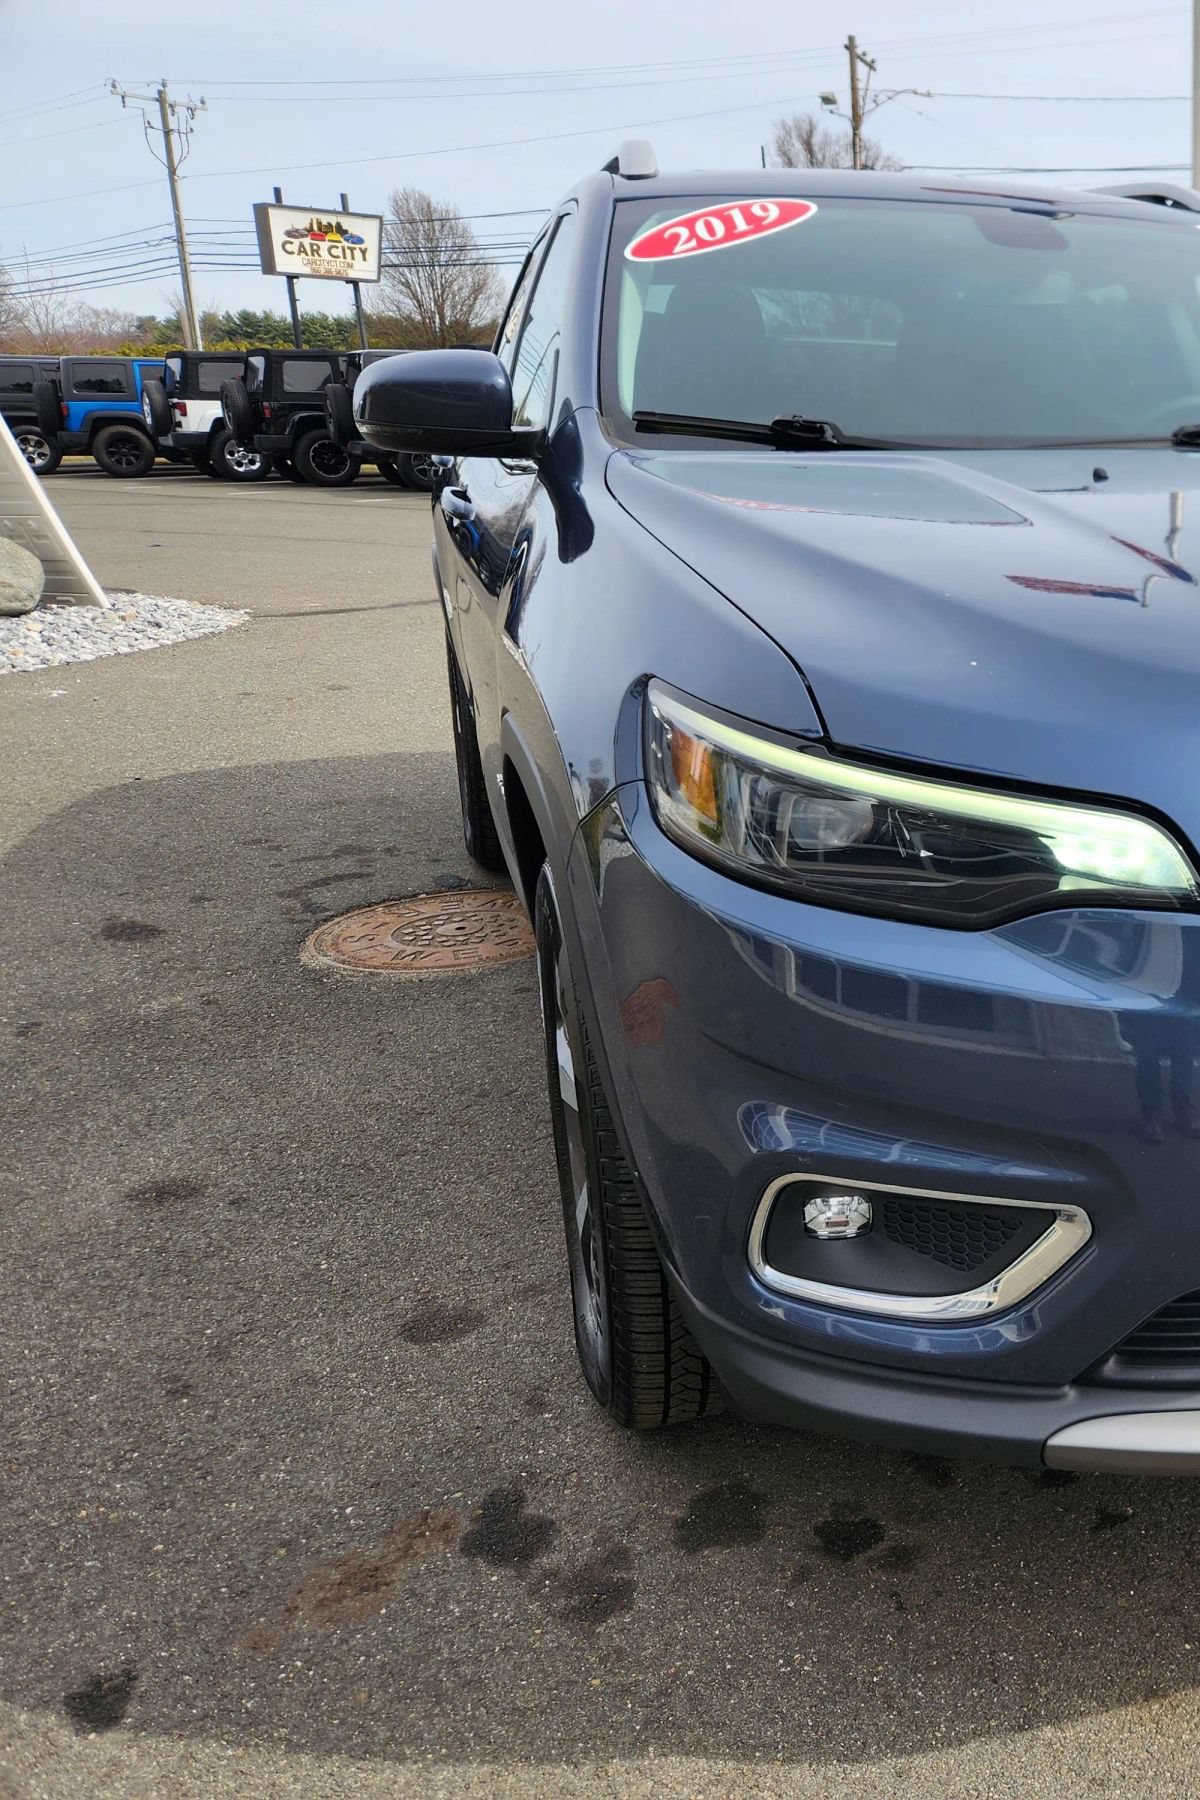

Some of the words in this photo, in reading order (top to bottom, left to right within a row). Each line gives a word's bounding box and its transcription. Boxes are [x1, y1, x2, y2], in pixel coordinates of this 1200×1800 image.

[663, 201, 780, 254] 2019
[281, 240, 322, 257] CAR
[327, 245, 368, 262] CITY
